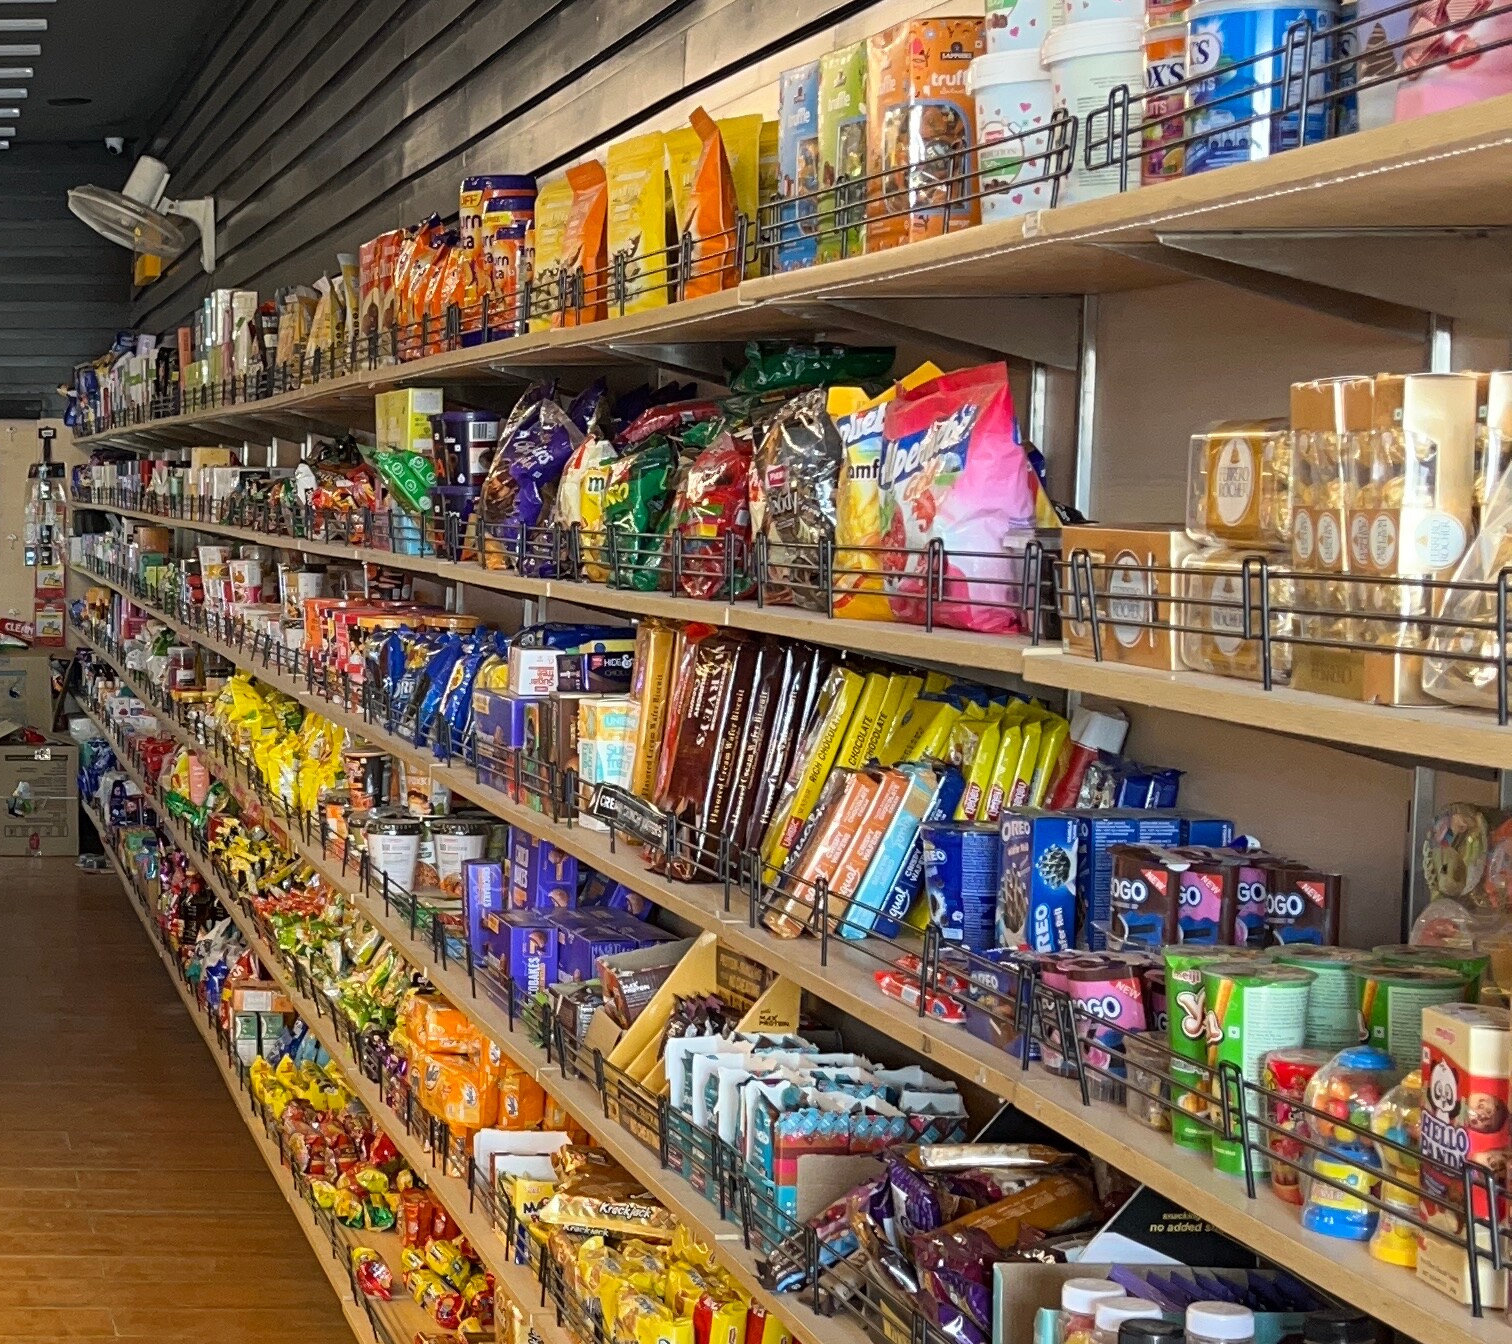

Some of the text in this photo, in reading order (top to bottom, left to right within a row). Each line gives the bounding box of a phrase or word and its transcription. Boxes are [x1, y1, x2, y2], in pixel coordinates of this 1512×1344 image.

[1218, 481, 1250, 498] ROCHER
[849, 715, 874, 767] CHOCOLATE
[1001, 820, 1031, 842] OREO
[1144, 870, 1167, 891] NEW
[1199, 875, 1222, 895] NEW
[1238, 882, 1267, 903] GO
[1301, 883, 1324, 904] NEW
[1114, 980, 1142, 1000] NEW
[1422, 1111, 1469, 1152] HELLO
[598, 1202, 652, 1220] Krackjack
